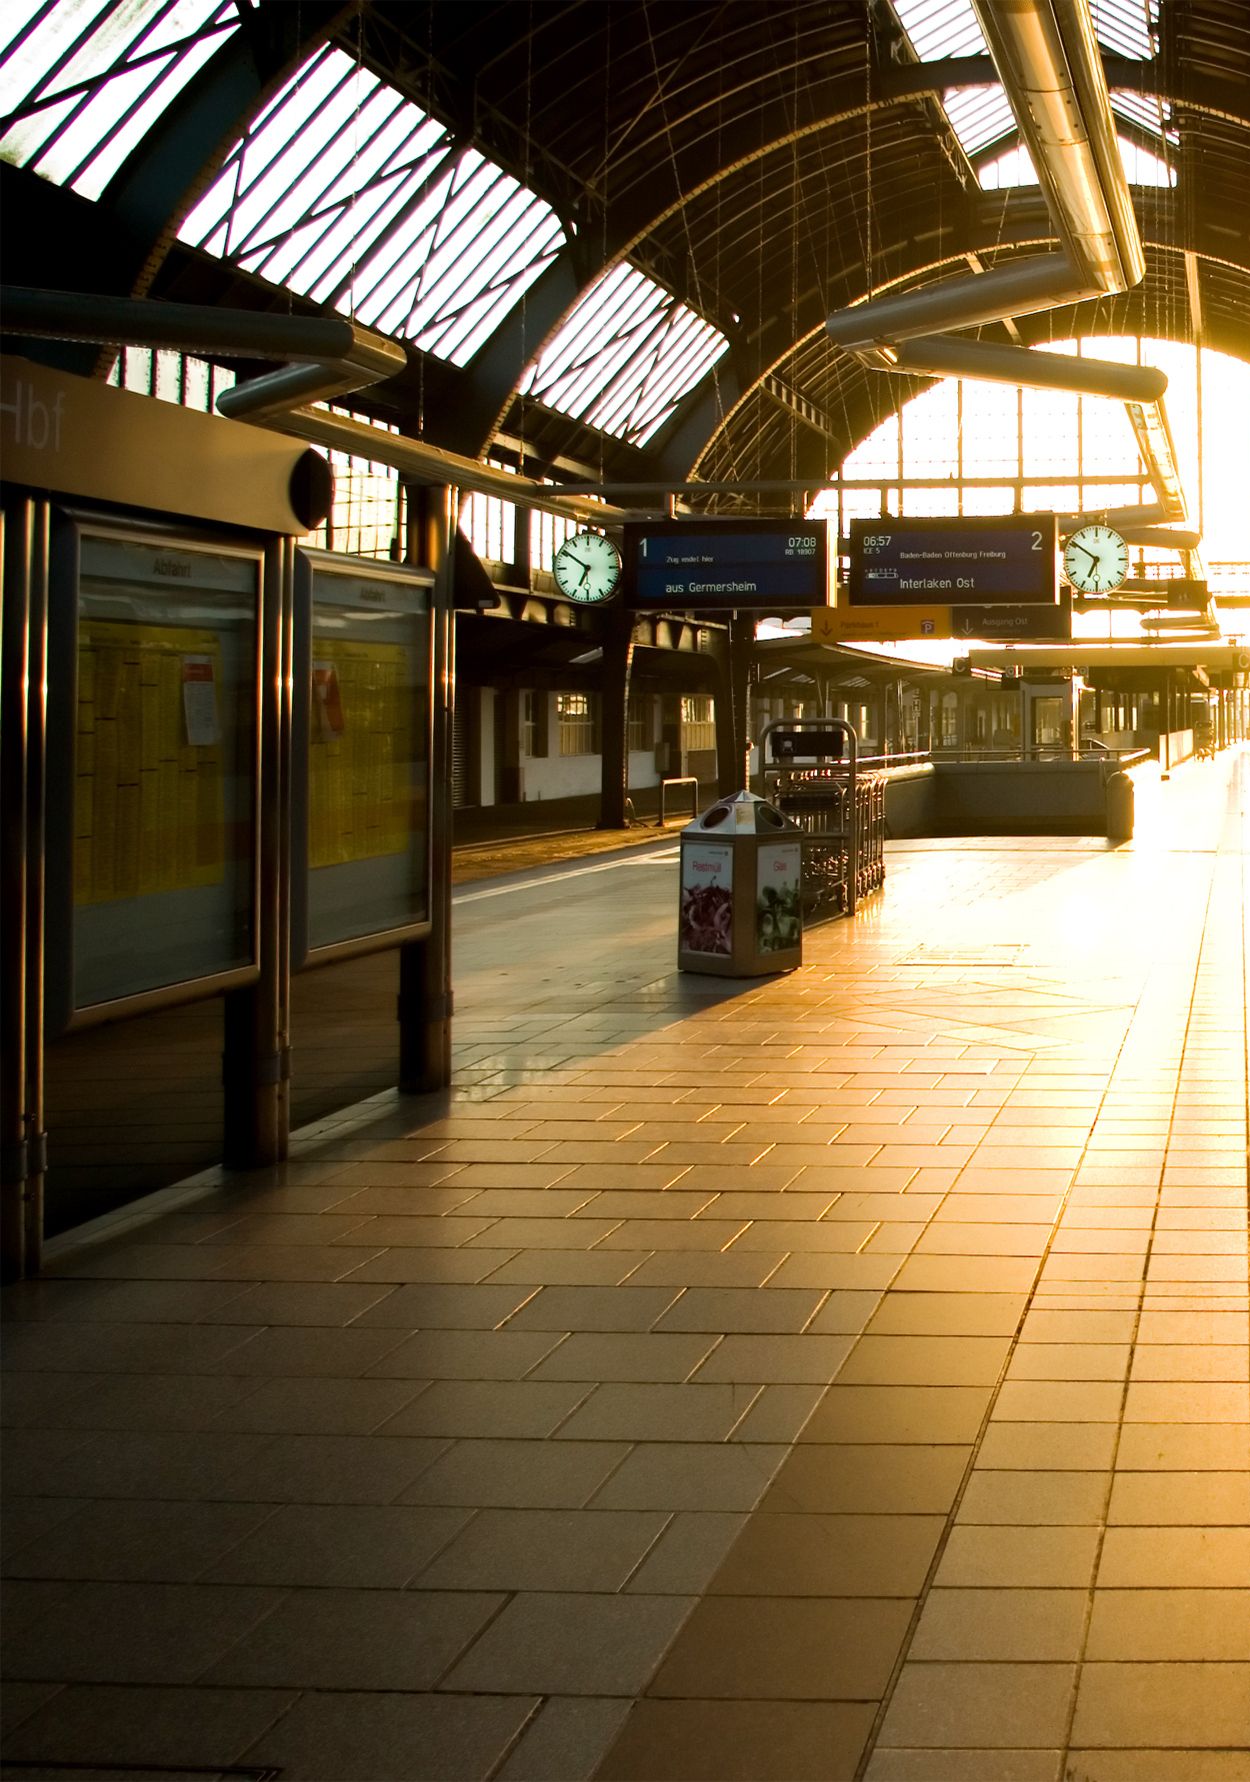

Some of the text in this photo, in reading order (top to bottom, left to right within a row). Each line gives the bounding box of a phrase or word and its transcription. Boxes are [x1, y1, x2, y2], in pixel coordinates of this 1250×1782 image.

[639, 537, 648, 558] 1
[788, 537, 817, 548] 07:08
[863, 535, 892, 547] 06:57
[1031, 531, 1043, 551] 2
[899, 550, 1007, 560] Baden-Baden Offenburg Freiburg
[153, 557, 192, 578] Abfahrt
[665, 581, 757, 593] aus Germersheim
[899, 577, 975, 590] Interlaken Ost
[1238, 652, 1250, 669] C
